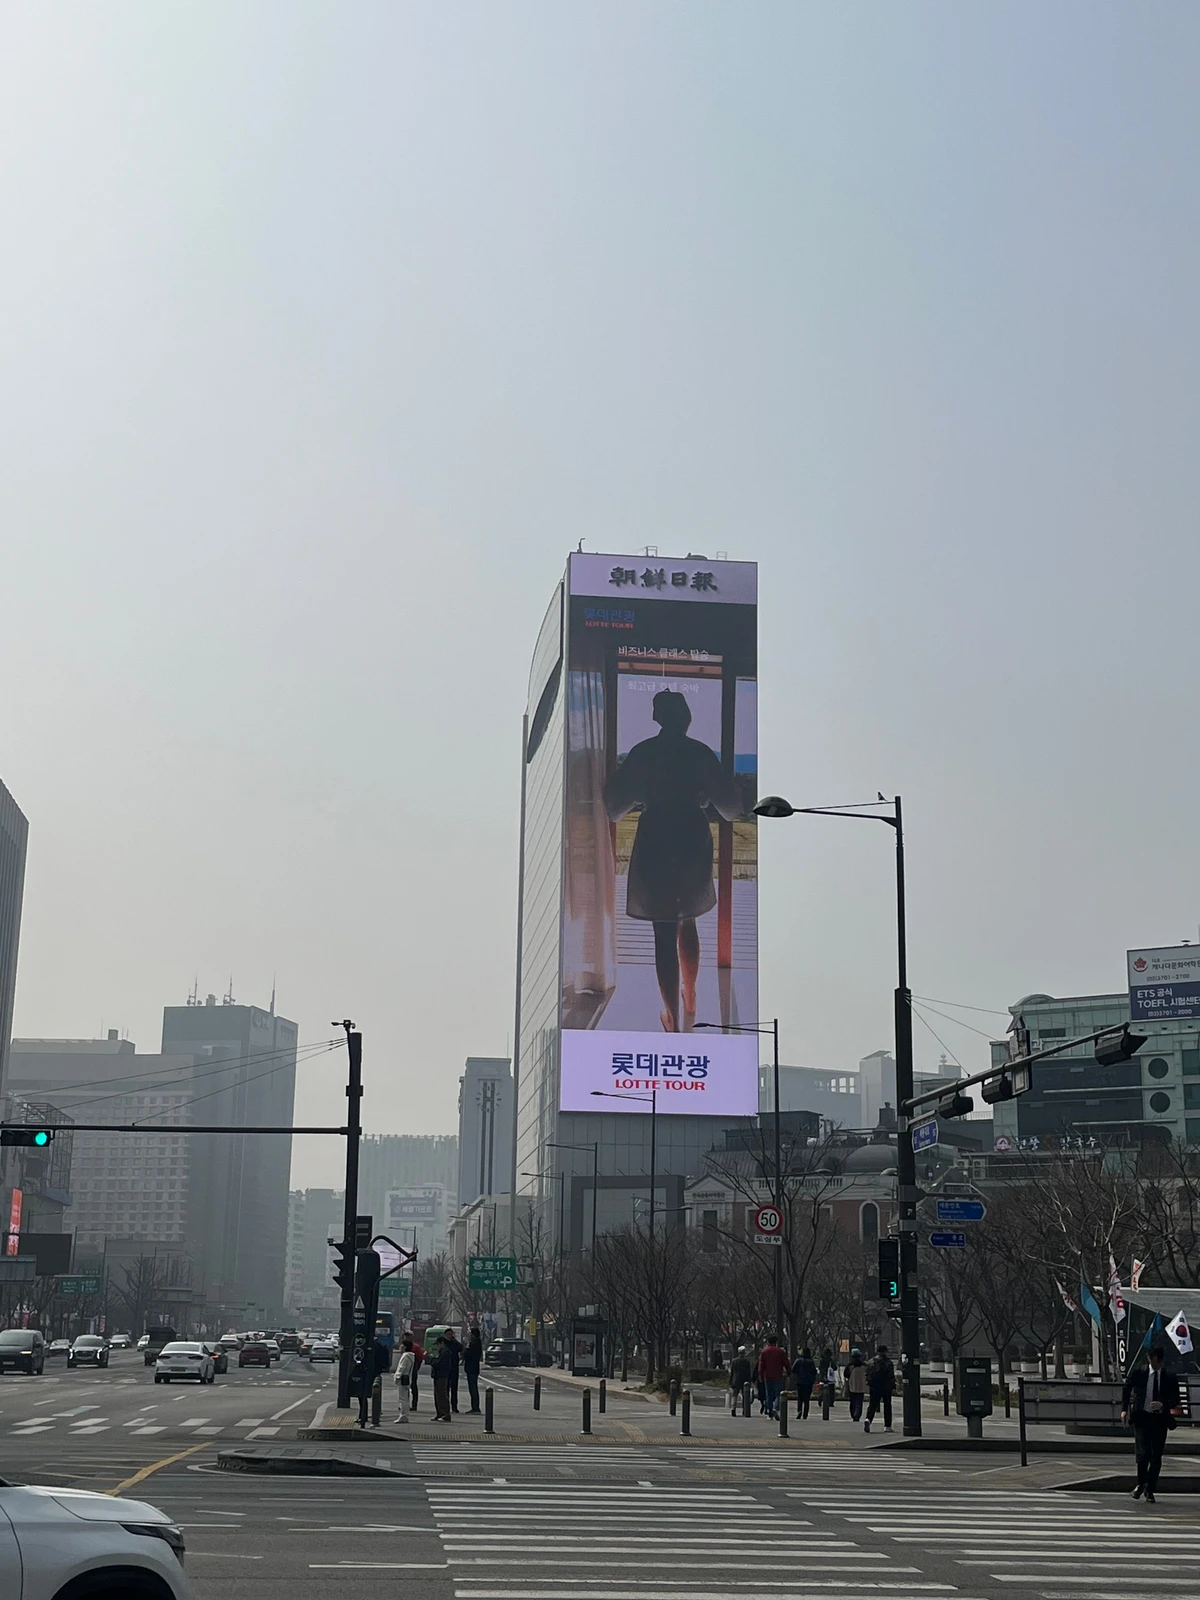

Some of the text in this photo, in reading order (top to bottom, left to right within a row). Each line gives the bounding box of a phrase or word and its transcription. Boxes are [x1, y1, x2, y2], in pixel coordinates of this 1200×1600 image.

[608, 566, 718, 592] 朝鮮日報
[584, 608, 635, 622] 롯데관광
[618, 646, 657, 657] 비즈니스
[659, 648, 687, 660] 클래스
[627, 681, 656, 692] 최고급
[1137, 987, 1173, 998] ETS 공식
[1138, 1000, 1169, 1008] TOEFL
[612, 1052, 710, 1079] 롯데관광
[615, 1078, 706, 1091] LOTTE TOUR
[760, 1212, 777, 1227] 50
[756, 1235, 781, 1243] 도심부
[472, 1260, 512, 1271] 종로1가
[889, 1281, 898, 1297] 3
[1119, 1340, 1126, 1363] 6
